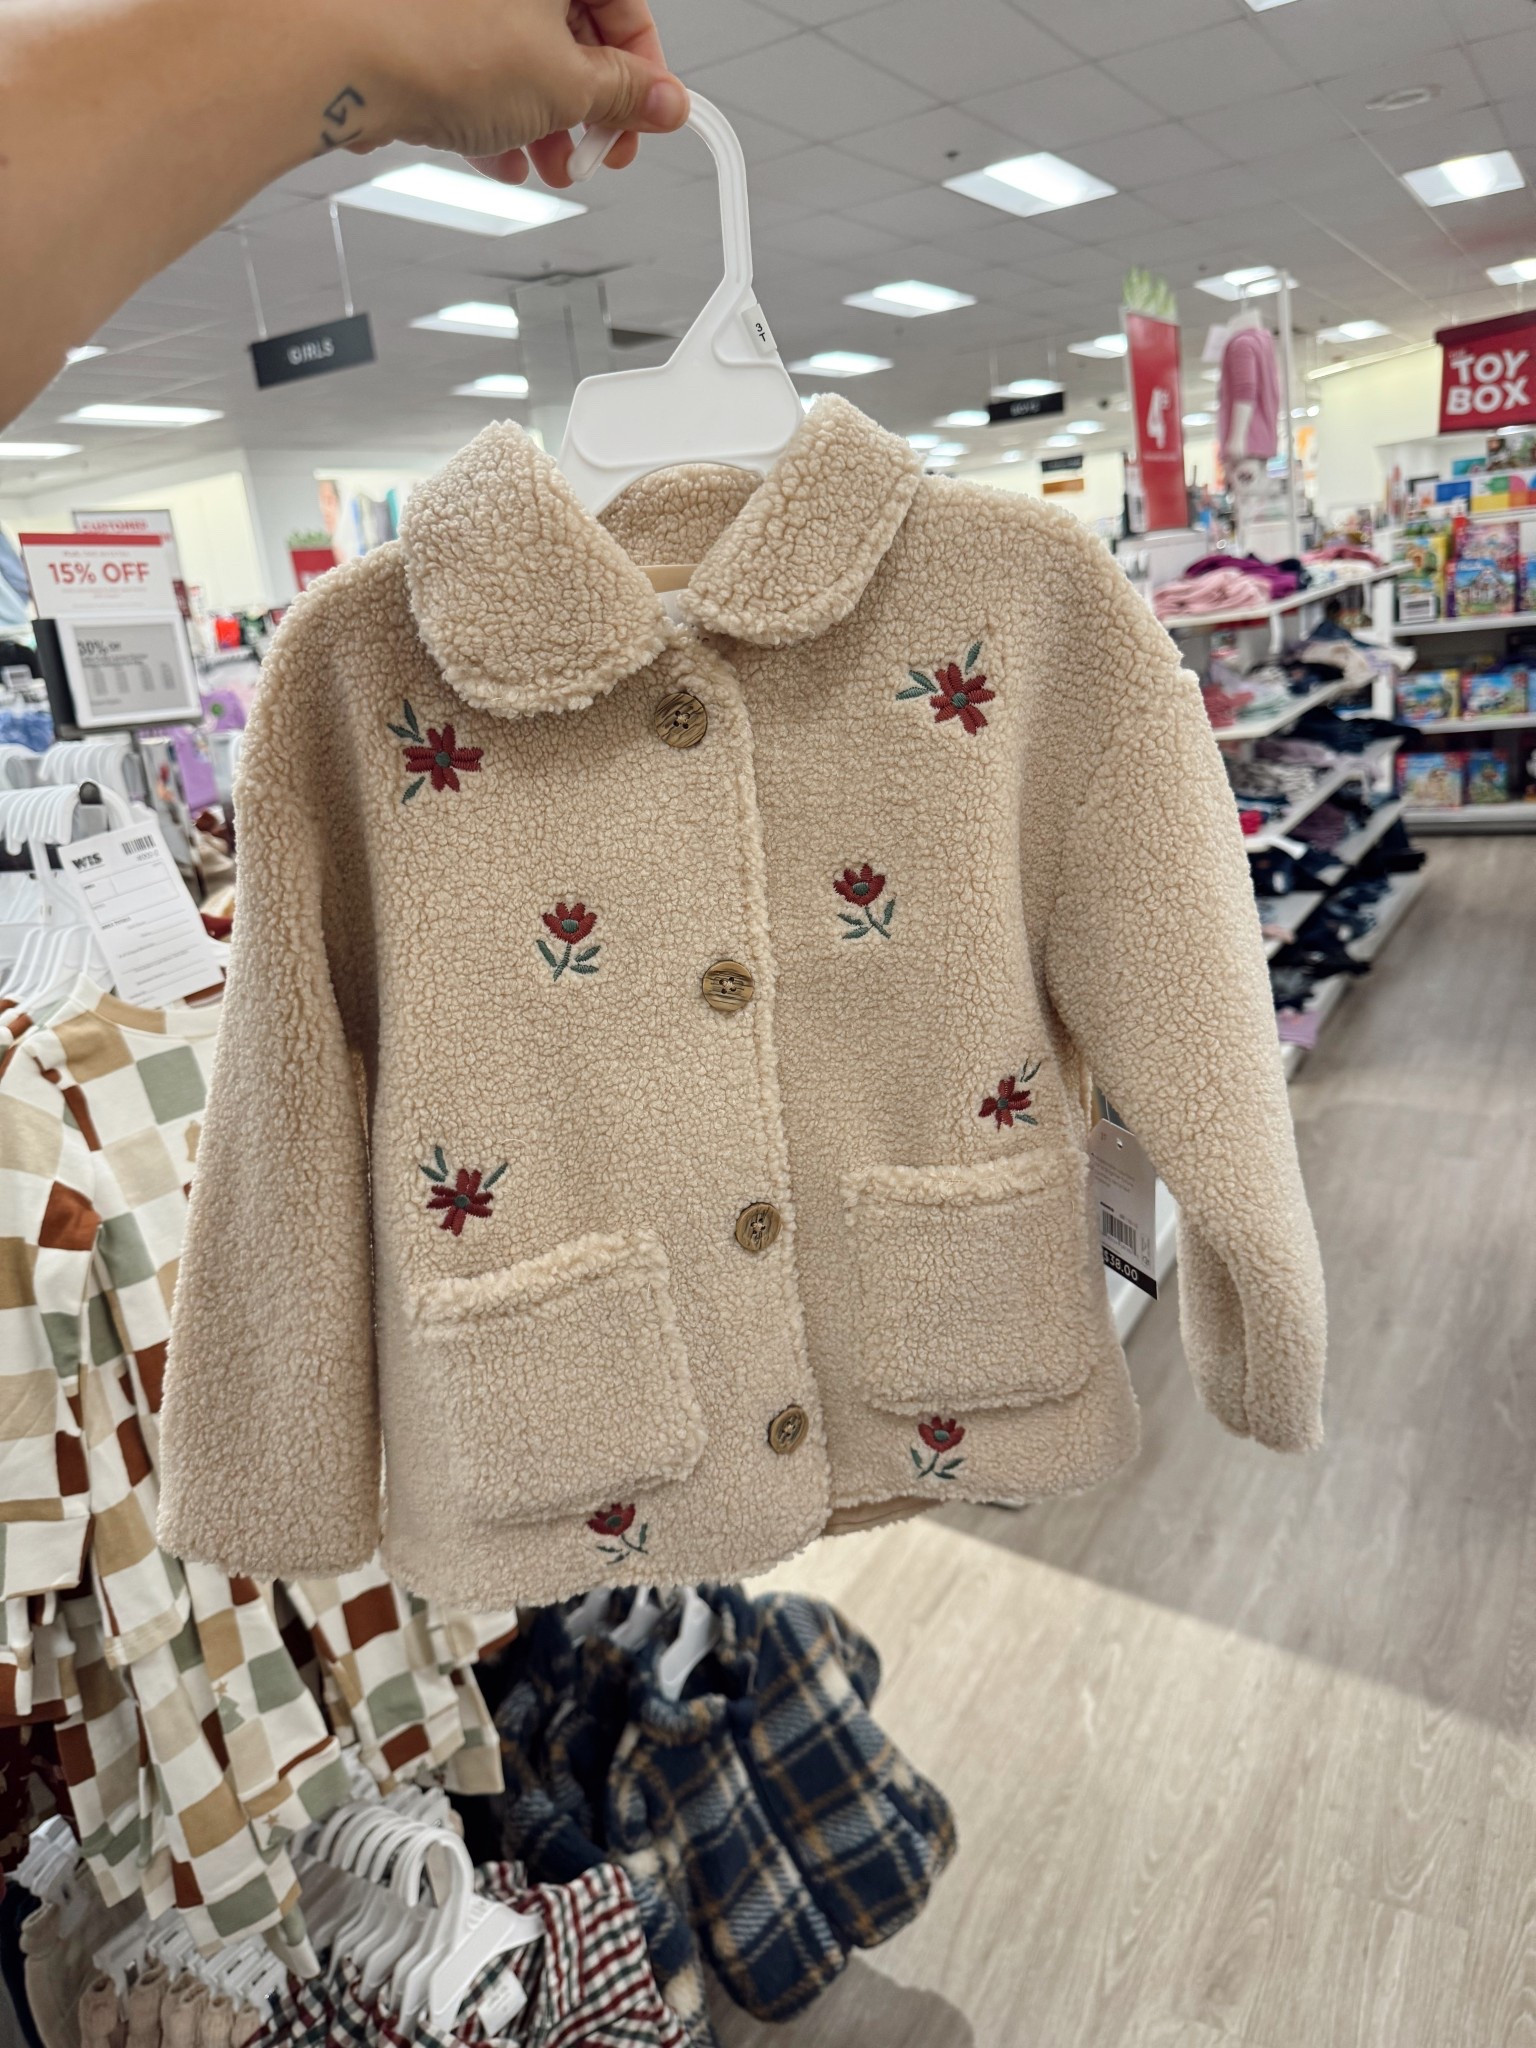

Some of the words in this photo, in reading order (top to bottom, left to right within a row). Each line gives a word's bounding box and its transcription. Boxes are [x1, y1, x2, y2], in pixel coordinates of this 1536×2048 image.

[287, 337, 335, 365] GIRLS
[1449, 348, 1530, 385] TOY
[1445, 376, 1531, 415] BOX
[48, 562, 97, 584] 15%
[102, 562, 150, 584] OFF
[1103, 1250, 1138, 1281] $38.00
